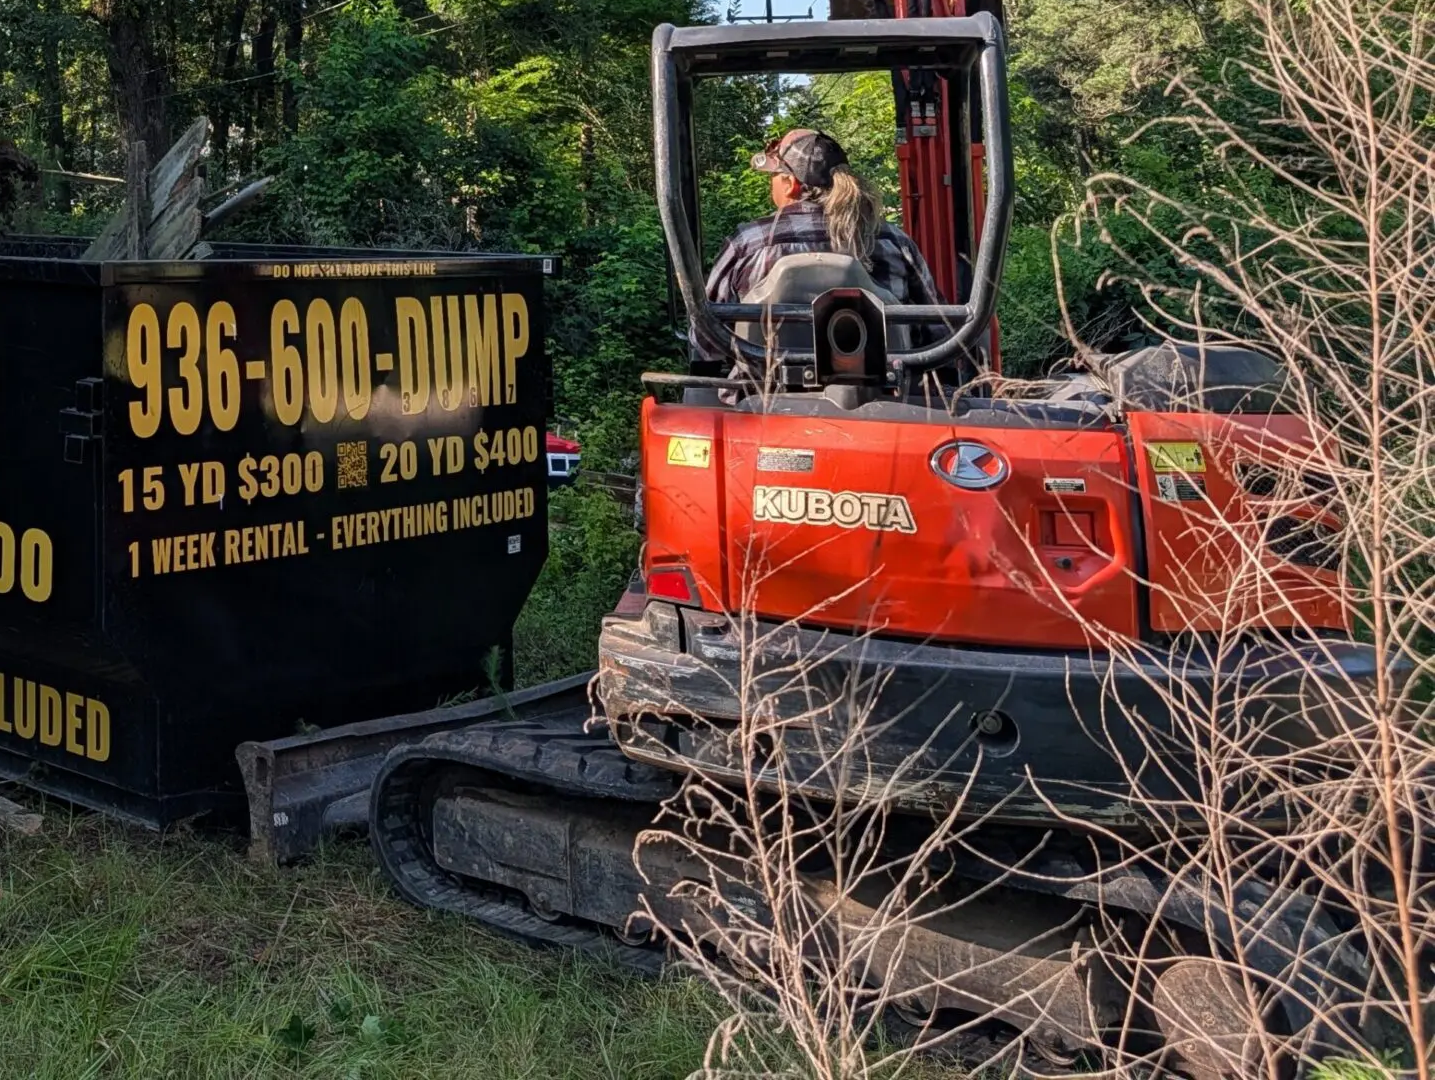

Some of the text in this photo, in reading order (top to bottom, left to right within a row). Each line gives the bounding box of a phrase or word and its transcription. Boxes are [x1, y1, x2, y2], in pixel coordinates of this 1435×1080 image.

[273, 264, 289, 278] DO
[294, 264, 316, 277] NOT
[346, 263, 383, 277] ABOVE
[385, 263, 410, 276] THIS
[414, 262, 436, 275] LINE
[127, 293, 529, 438] 936-600-DUMP
[118, 426, 538, 512] 15 YD $300 20 YD $400
[755, 488, 914, 530] KUBOTA
[128, 541, 139, 578] 1
[152, 531, 216, 575] WEEK
[224, 521, 308, 564] RENTAL
[331, 497, 449, 550] EVERYTHING
[453, 487, 535, 527] INCLUDED
